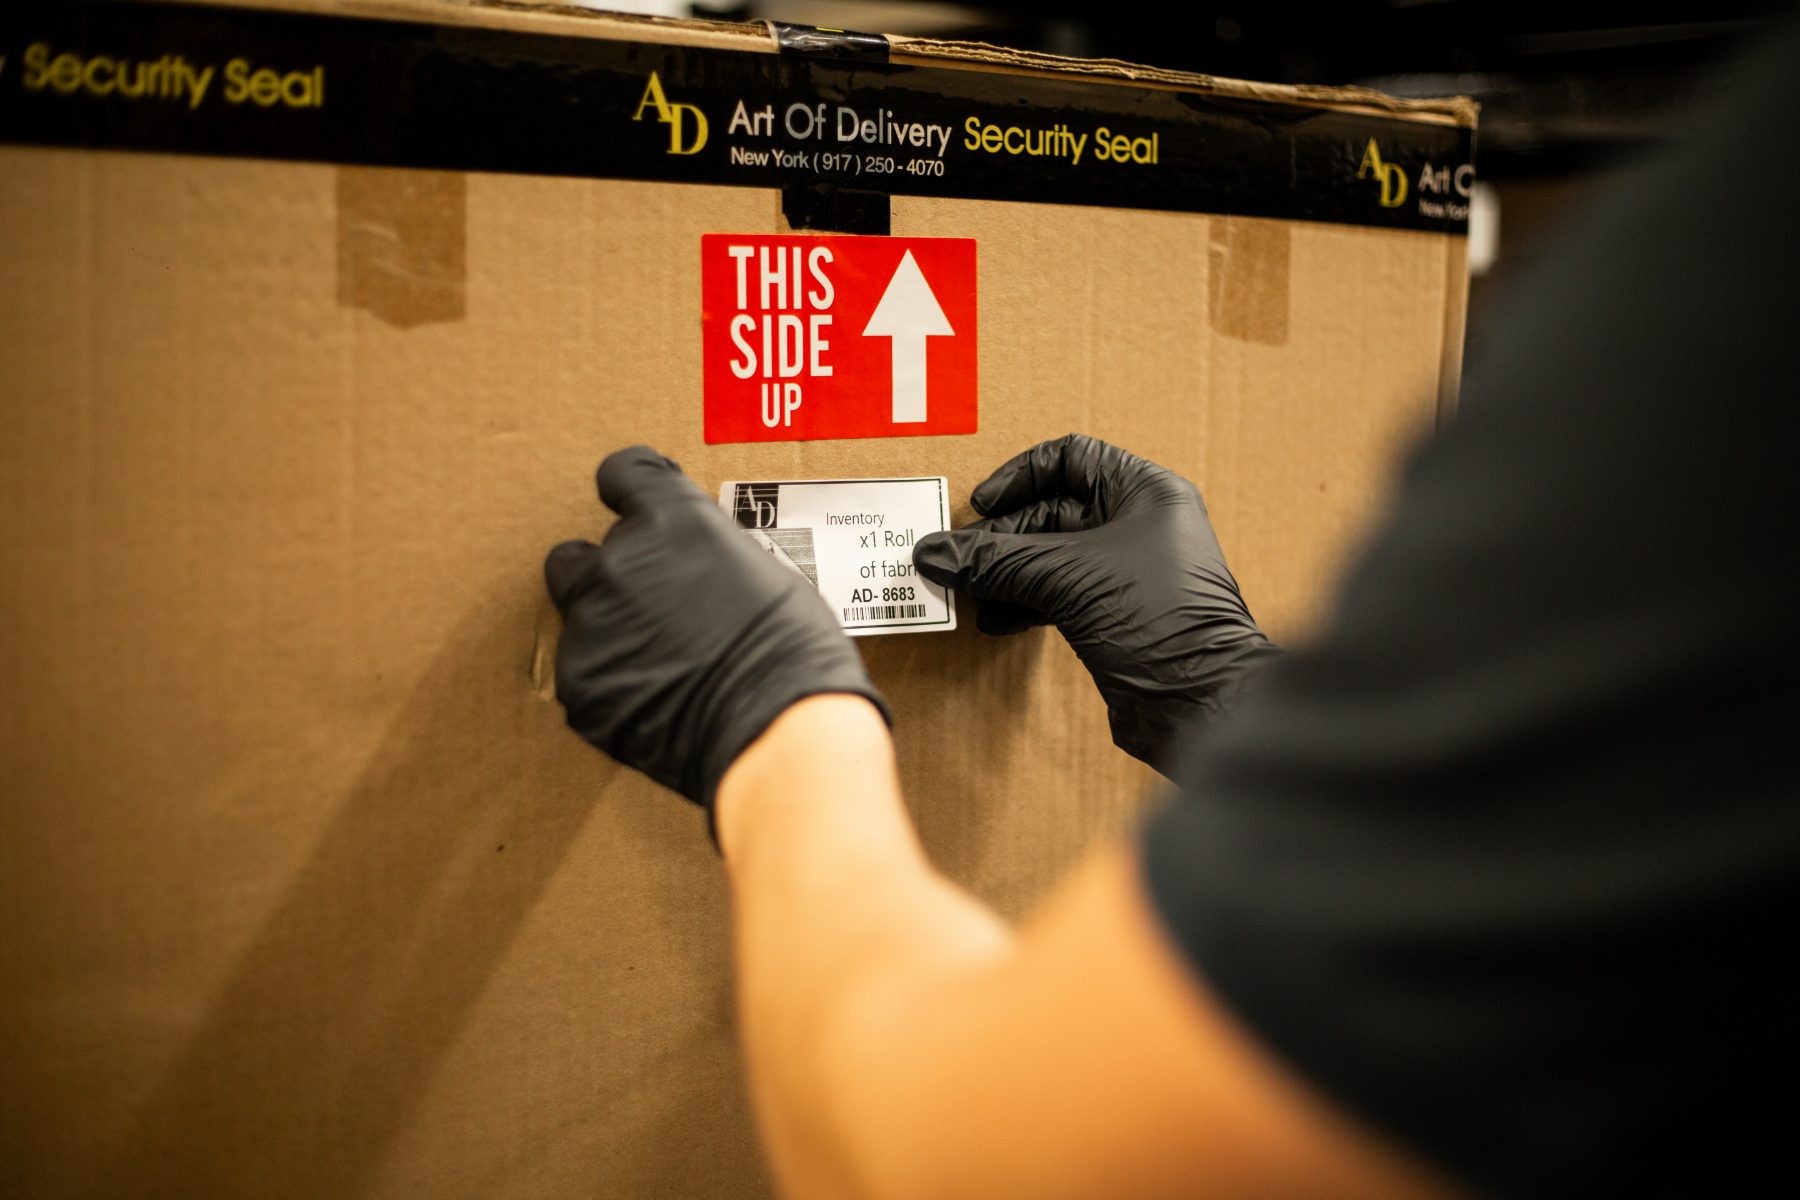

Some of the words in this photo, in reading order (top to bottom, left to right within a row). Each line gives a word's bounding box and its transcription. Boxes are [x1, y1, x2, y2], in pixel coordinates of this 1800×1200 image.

[23, 42, 214, 110] Security
[224, 58, 324, 108] Seal
[728, 100, 774, 136] Art
[785, 103, 826, 140] Of
[837, 107, 951, 157] Delivery
[964, 116, 1087, 166] Security
[1095, 128, 1159, 165] Seal
[731, 147, 769, 167] New
[772, 149, 809, 169] York
[1418, 161, 1450, 194] Art
[728, 246, 835, 311] THIS
[730, 313, 834, 380] SIDE
[761, 382, 803, 428] UP
[826, 512, 885, 528] Inventory
[859, 531, 877, 548] x1
[884, 528, 915, 547] Roll
[860, 560, 876, 578] of
